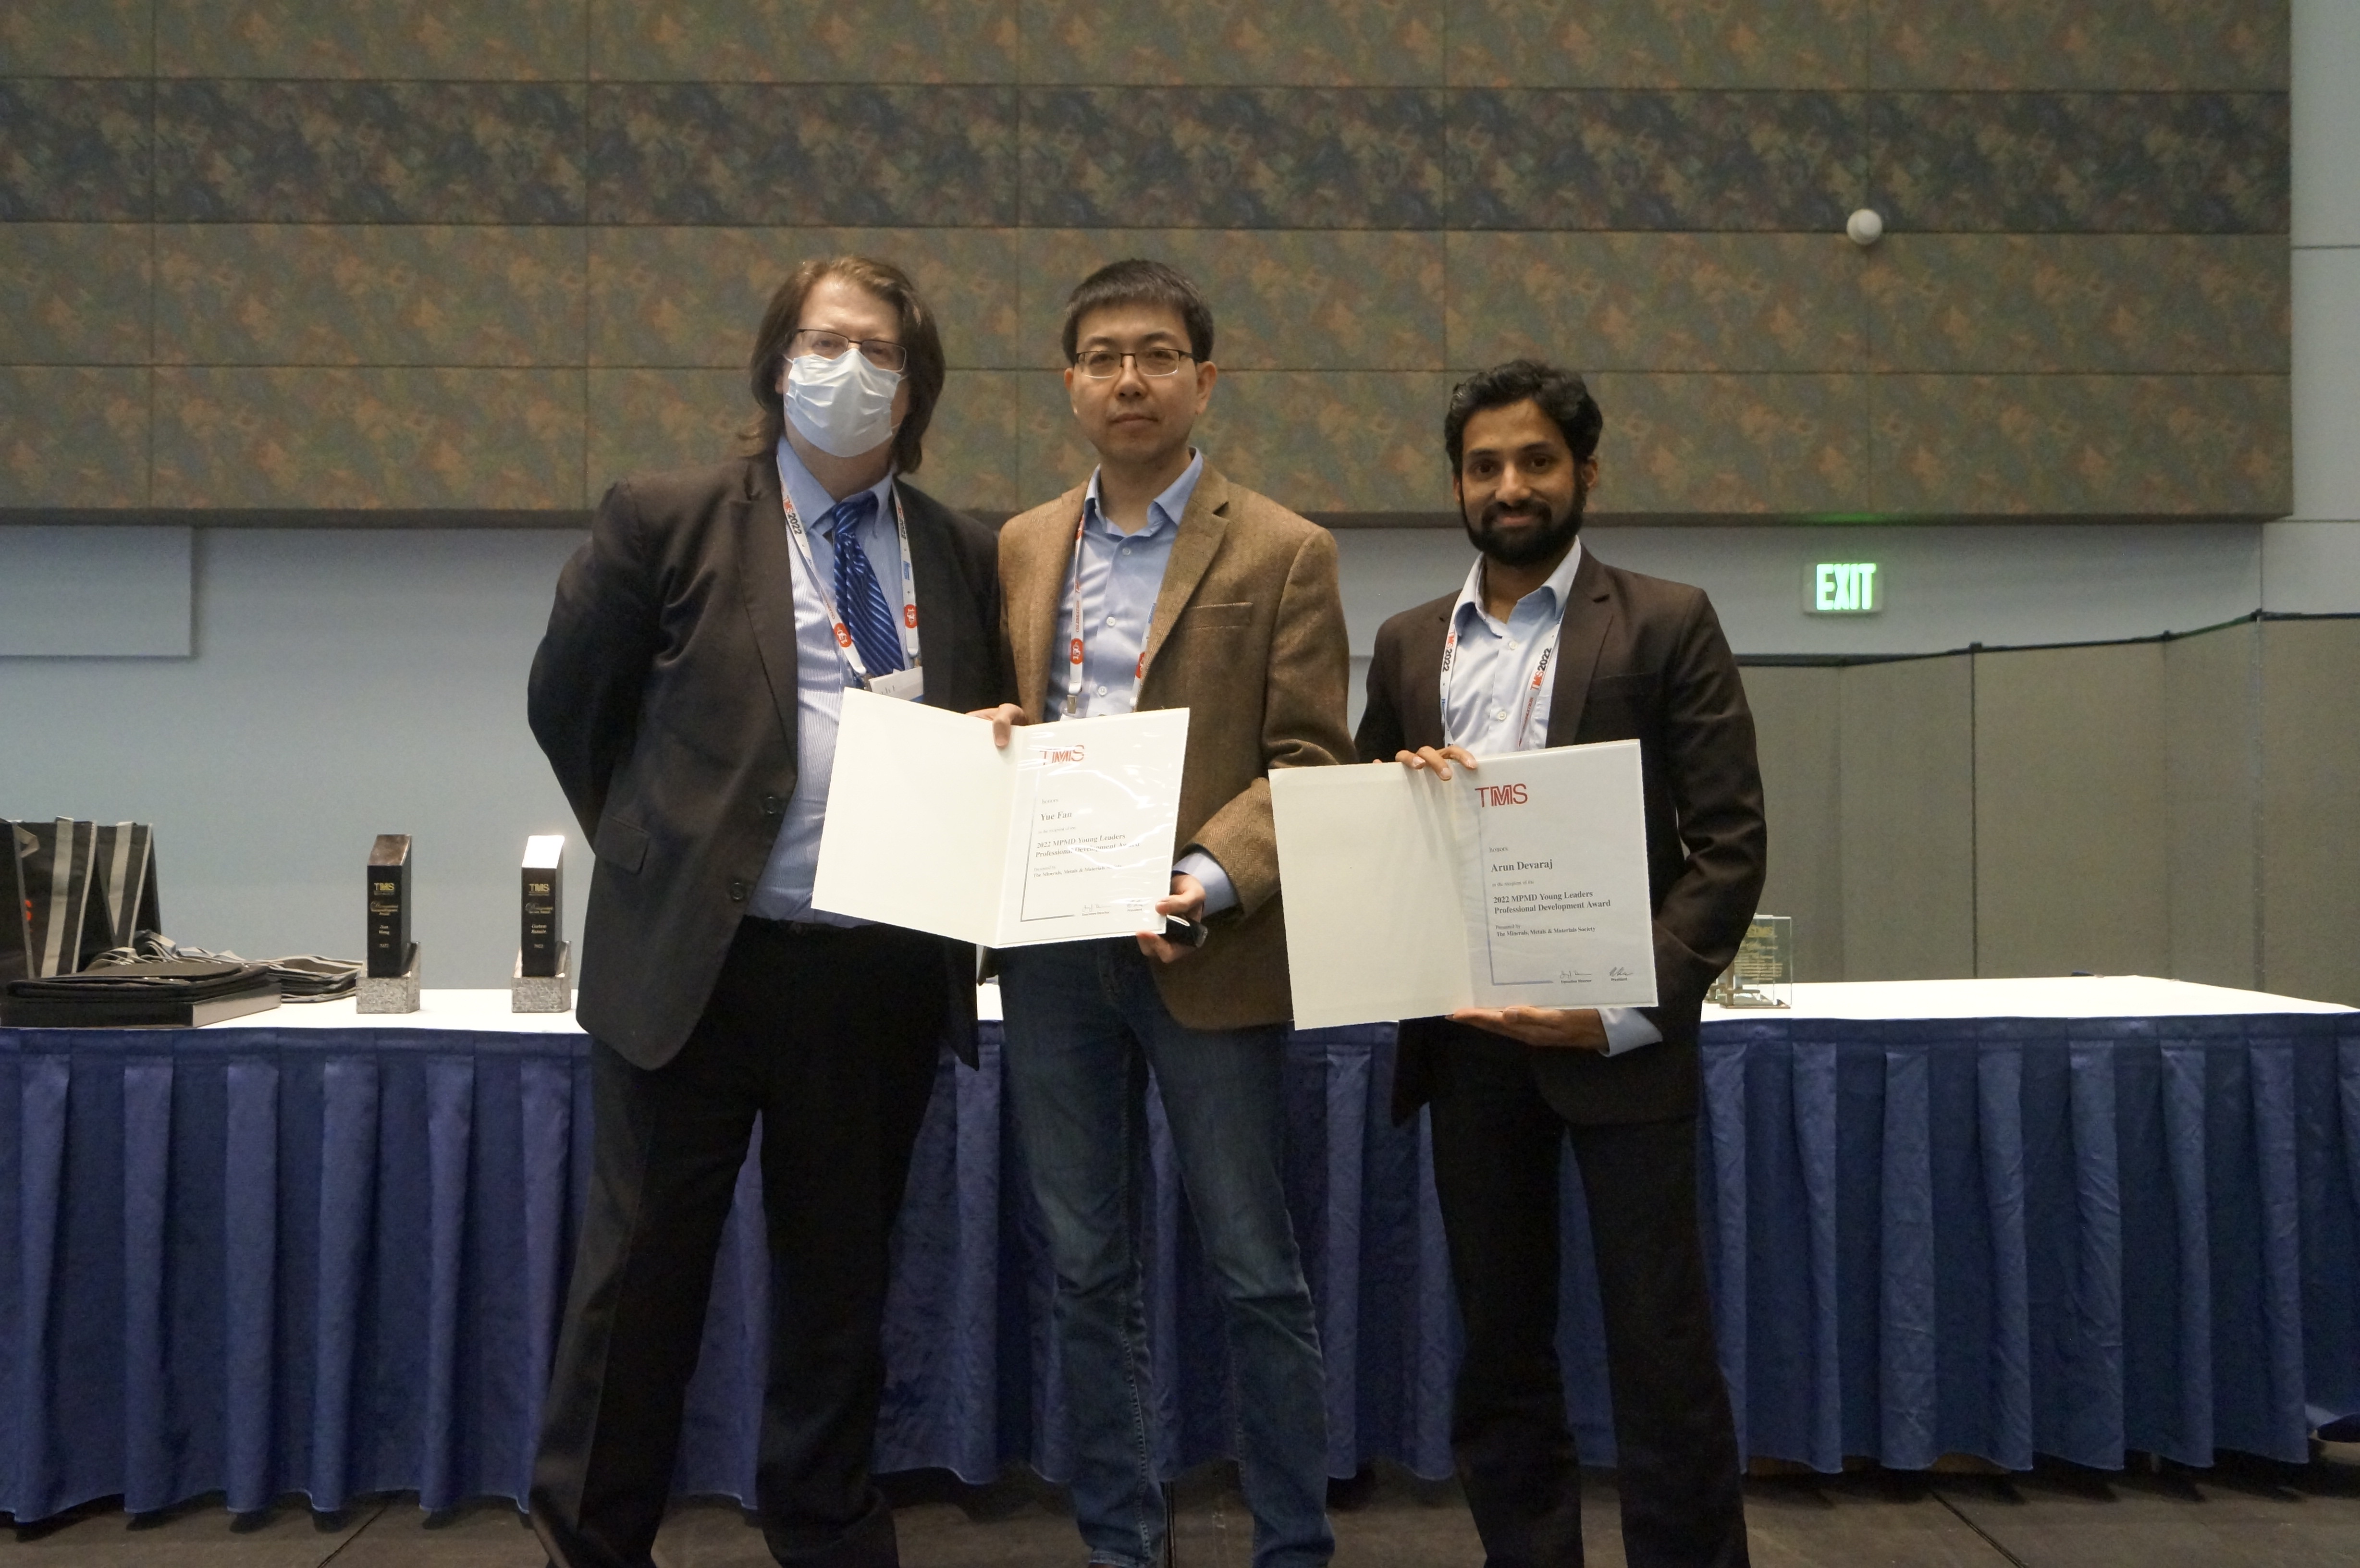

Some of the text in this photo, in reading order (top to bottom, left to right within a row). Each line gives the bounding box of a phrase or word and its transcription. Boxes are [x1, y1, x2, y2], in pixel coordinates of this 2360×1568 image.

[1816, 563, 1876, 610] EXIT
[1475, 783, 1528, 808] TMS
[1491, 858, 1553, 872] Arun Devaraj
[374, 882, 395, 891] TMS
[1512, 894, 1537, 902] MPMD
[1564, 891, 1593, 899] Leaders
[1494, 899, 1610, 914] Professional Development Award
